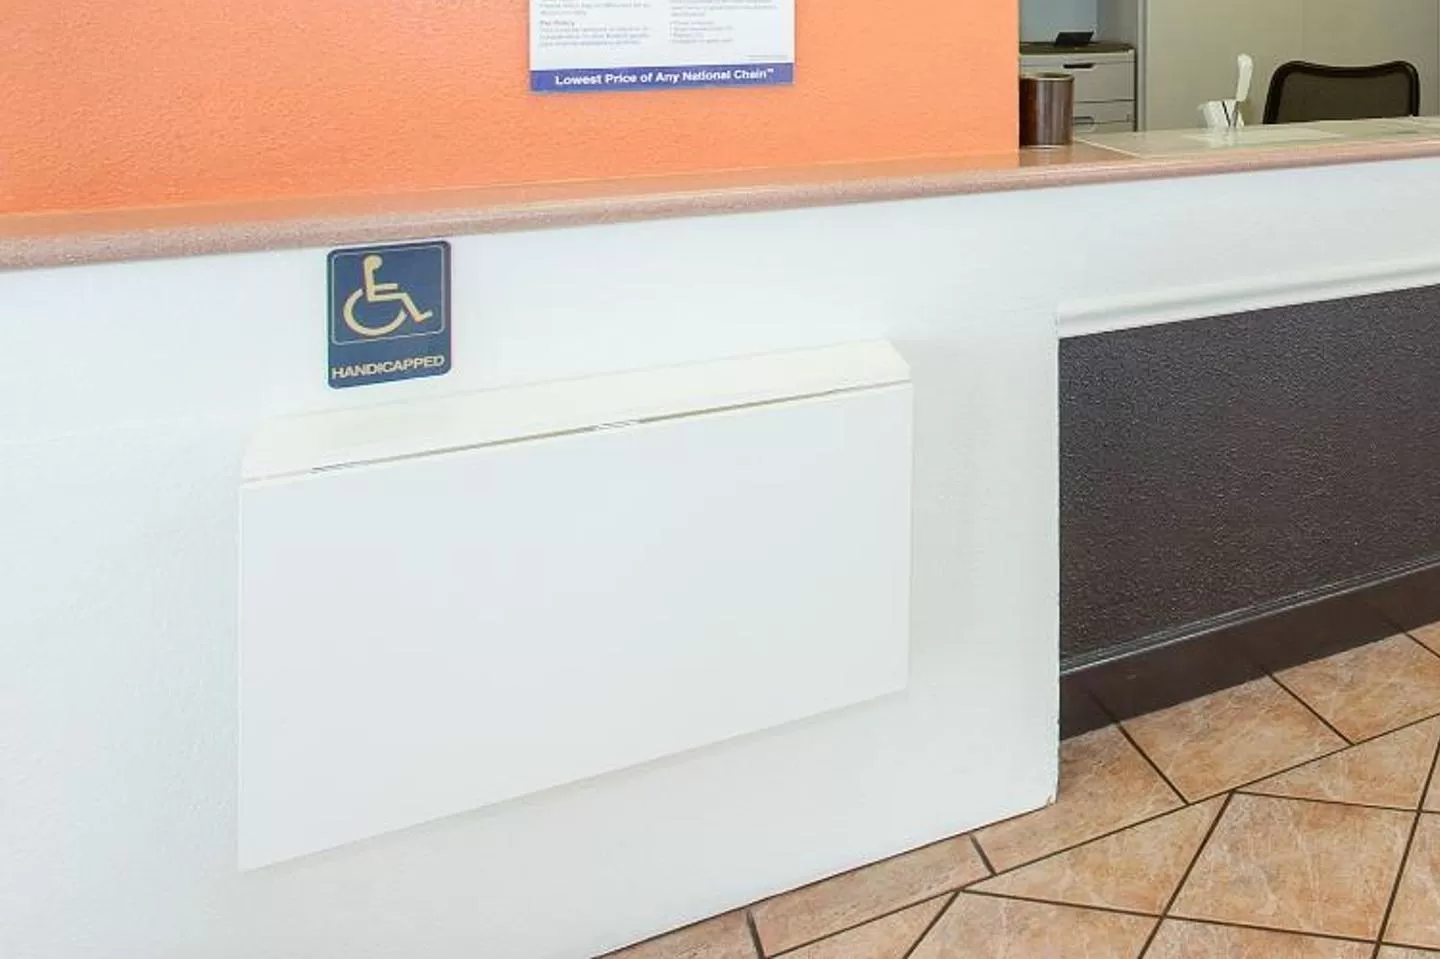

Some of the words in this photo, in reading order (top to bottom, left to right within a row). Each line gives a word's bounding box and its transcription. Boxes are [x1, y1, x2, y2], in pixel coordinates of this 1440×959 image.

[555, 74, 602, 86] Lowest
[605, 73, 636, 84] Price
[639, 72, 653, 83] of
[655, 71, 680, 84] Any
[682, 69, 731, 81] National
[332, 355, 445, 379] HANDICAPPED
